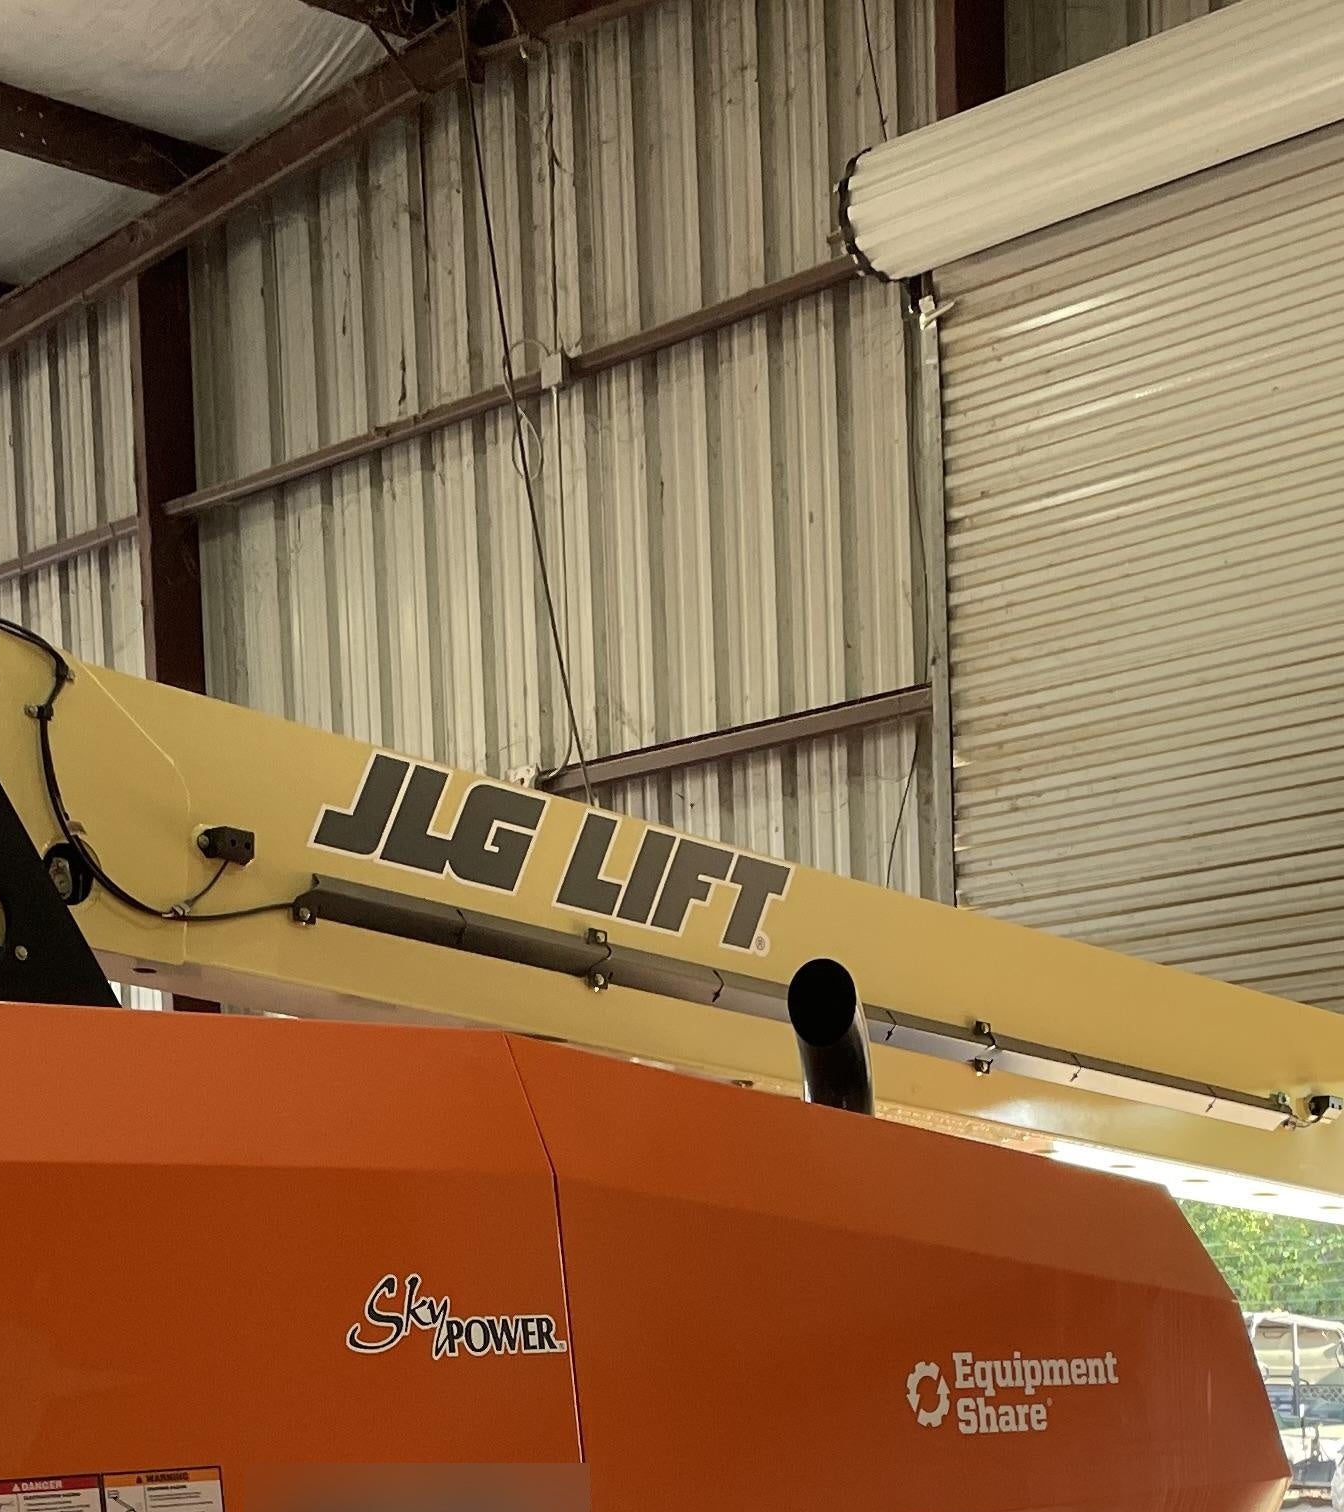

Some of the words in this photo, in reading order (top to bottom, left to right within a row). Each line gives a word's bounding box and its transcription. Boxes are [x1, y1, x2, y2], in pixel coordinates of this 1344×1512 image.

[309, 751, 549, 895] JLG
[553, 810, 794, 953] LIFT
[952, 1351, 1120, 1396] Equipment
[956, 1397, 1049, 1434] Share
[21, 1479, 63, 1492] DANGER
[145, 1472, 190, 1483] WARNING
